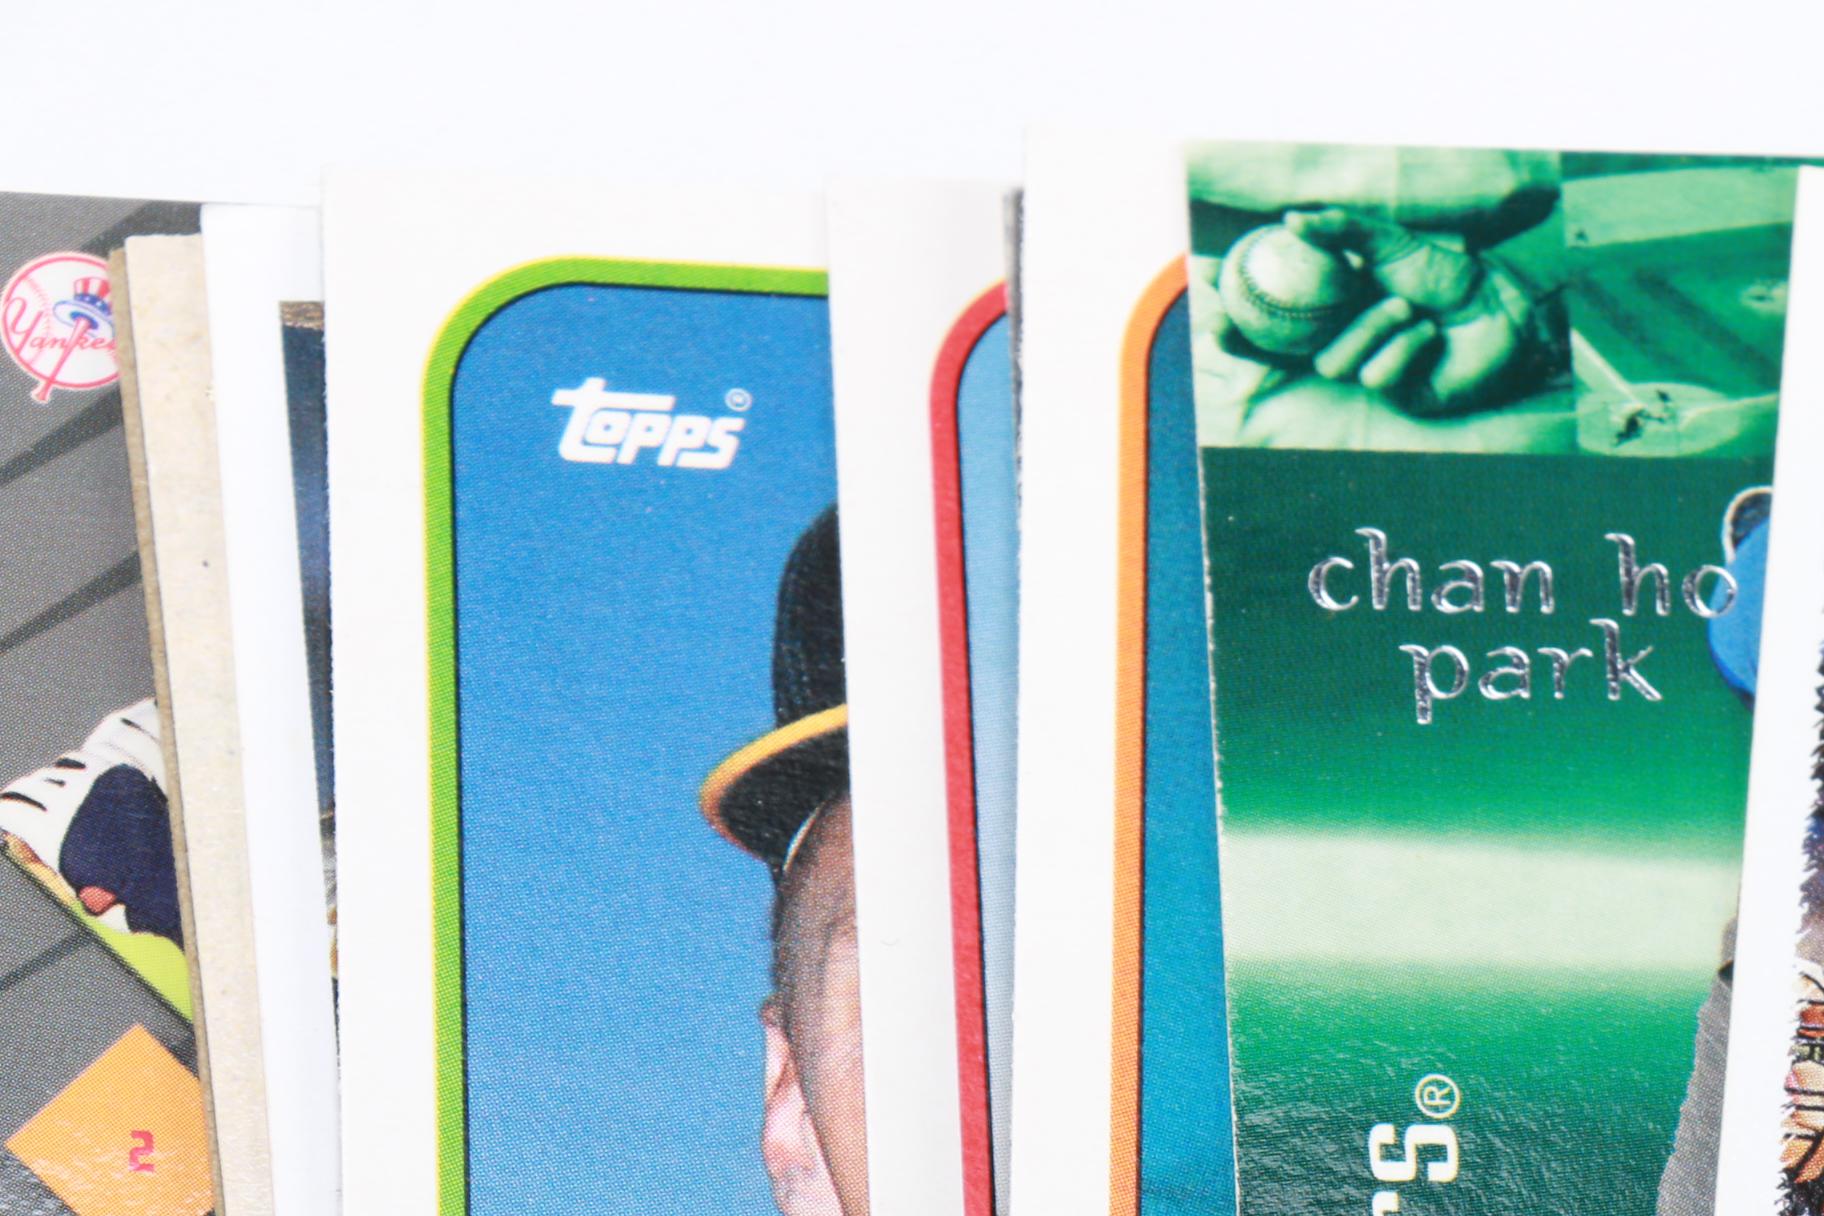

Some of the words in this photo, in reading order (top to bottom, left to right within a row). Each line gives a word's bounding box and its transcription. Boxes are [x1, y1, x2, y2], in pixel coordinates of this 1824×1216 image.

[1307, 527, 1555, 614] chan
[1604, 532, 1738, 618] ho
[1398, 618, 1662, 725] park
[128, 1130, 156, 1173] 2
